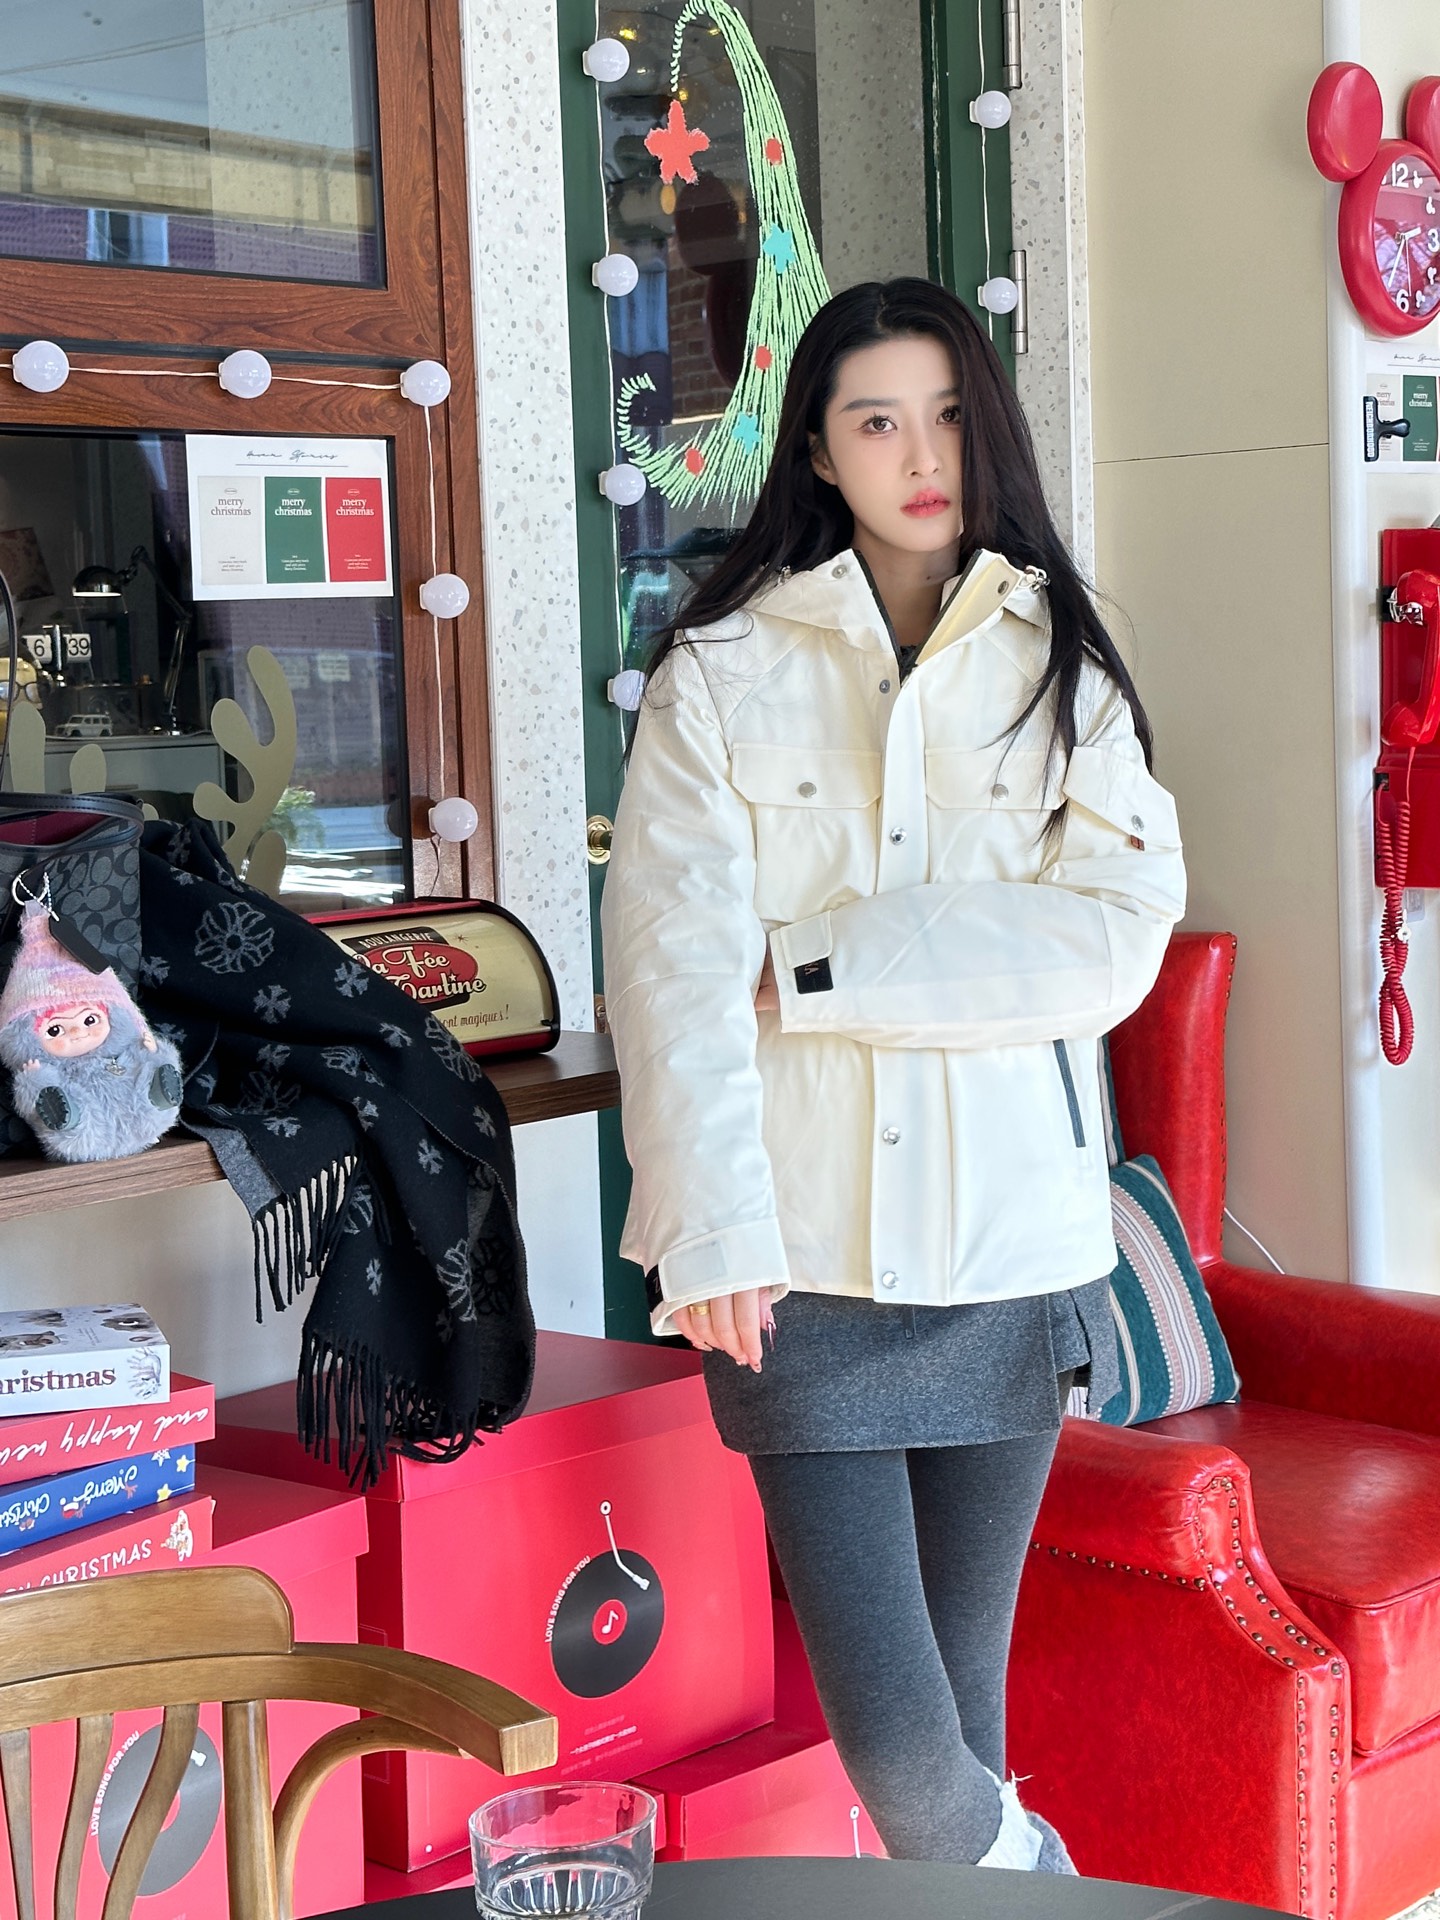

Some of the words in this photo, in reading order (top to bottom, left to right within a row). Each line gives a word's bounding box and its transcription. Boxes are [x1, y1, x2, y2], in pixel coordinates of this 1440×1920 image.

[1392, 162, 1409, 188] 12
[1428, 228, 1440, 253] 3
[1396, 289, 1410, 314] 6
[211, 506, 251, 516] christmas
[218, 498, 244, 508] merry
[274, 506, 312, 516] christmas
[281, 498, 305, 508] merry
[336, 506, 374, 516] christmas
[342, 498, 367, 508] merry
[34, 639, 45, 656] 6
[68, 638, 90, 656] 39
[358, 932, 433, 949] BOULANGERIE
[382, 946, 450, 978] Fée
[442, 1014, 458, 1029] ont
[60, 1414, 143, 1452] happy
[152, 1407, 209, 1442] and
[73, 1465, 138, 1505] Merry
[0, 1494, 50, 1528] Christ
[40, 1539, 152, 1587] CHRISTMAS
[545, 1617, 555, 1643] LOVE
[550, 1589, 565, 1616] SONG
[562, 1571, 577, 1590] FOR
[574, 1555, 591, 1572] YOU
[122, 1730, 140, 1751] YOU
[108, 1750, 124, 1772] FOR
[95, 1773, 112, 1805] SONG
[91, 1806, 101, 1836] LOVE
